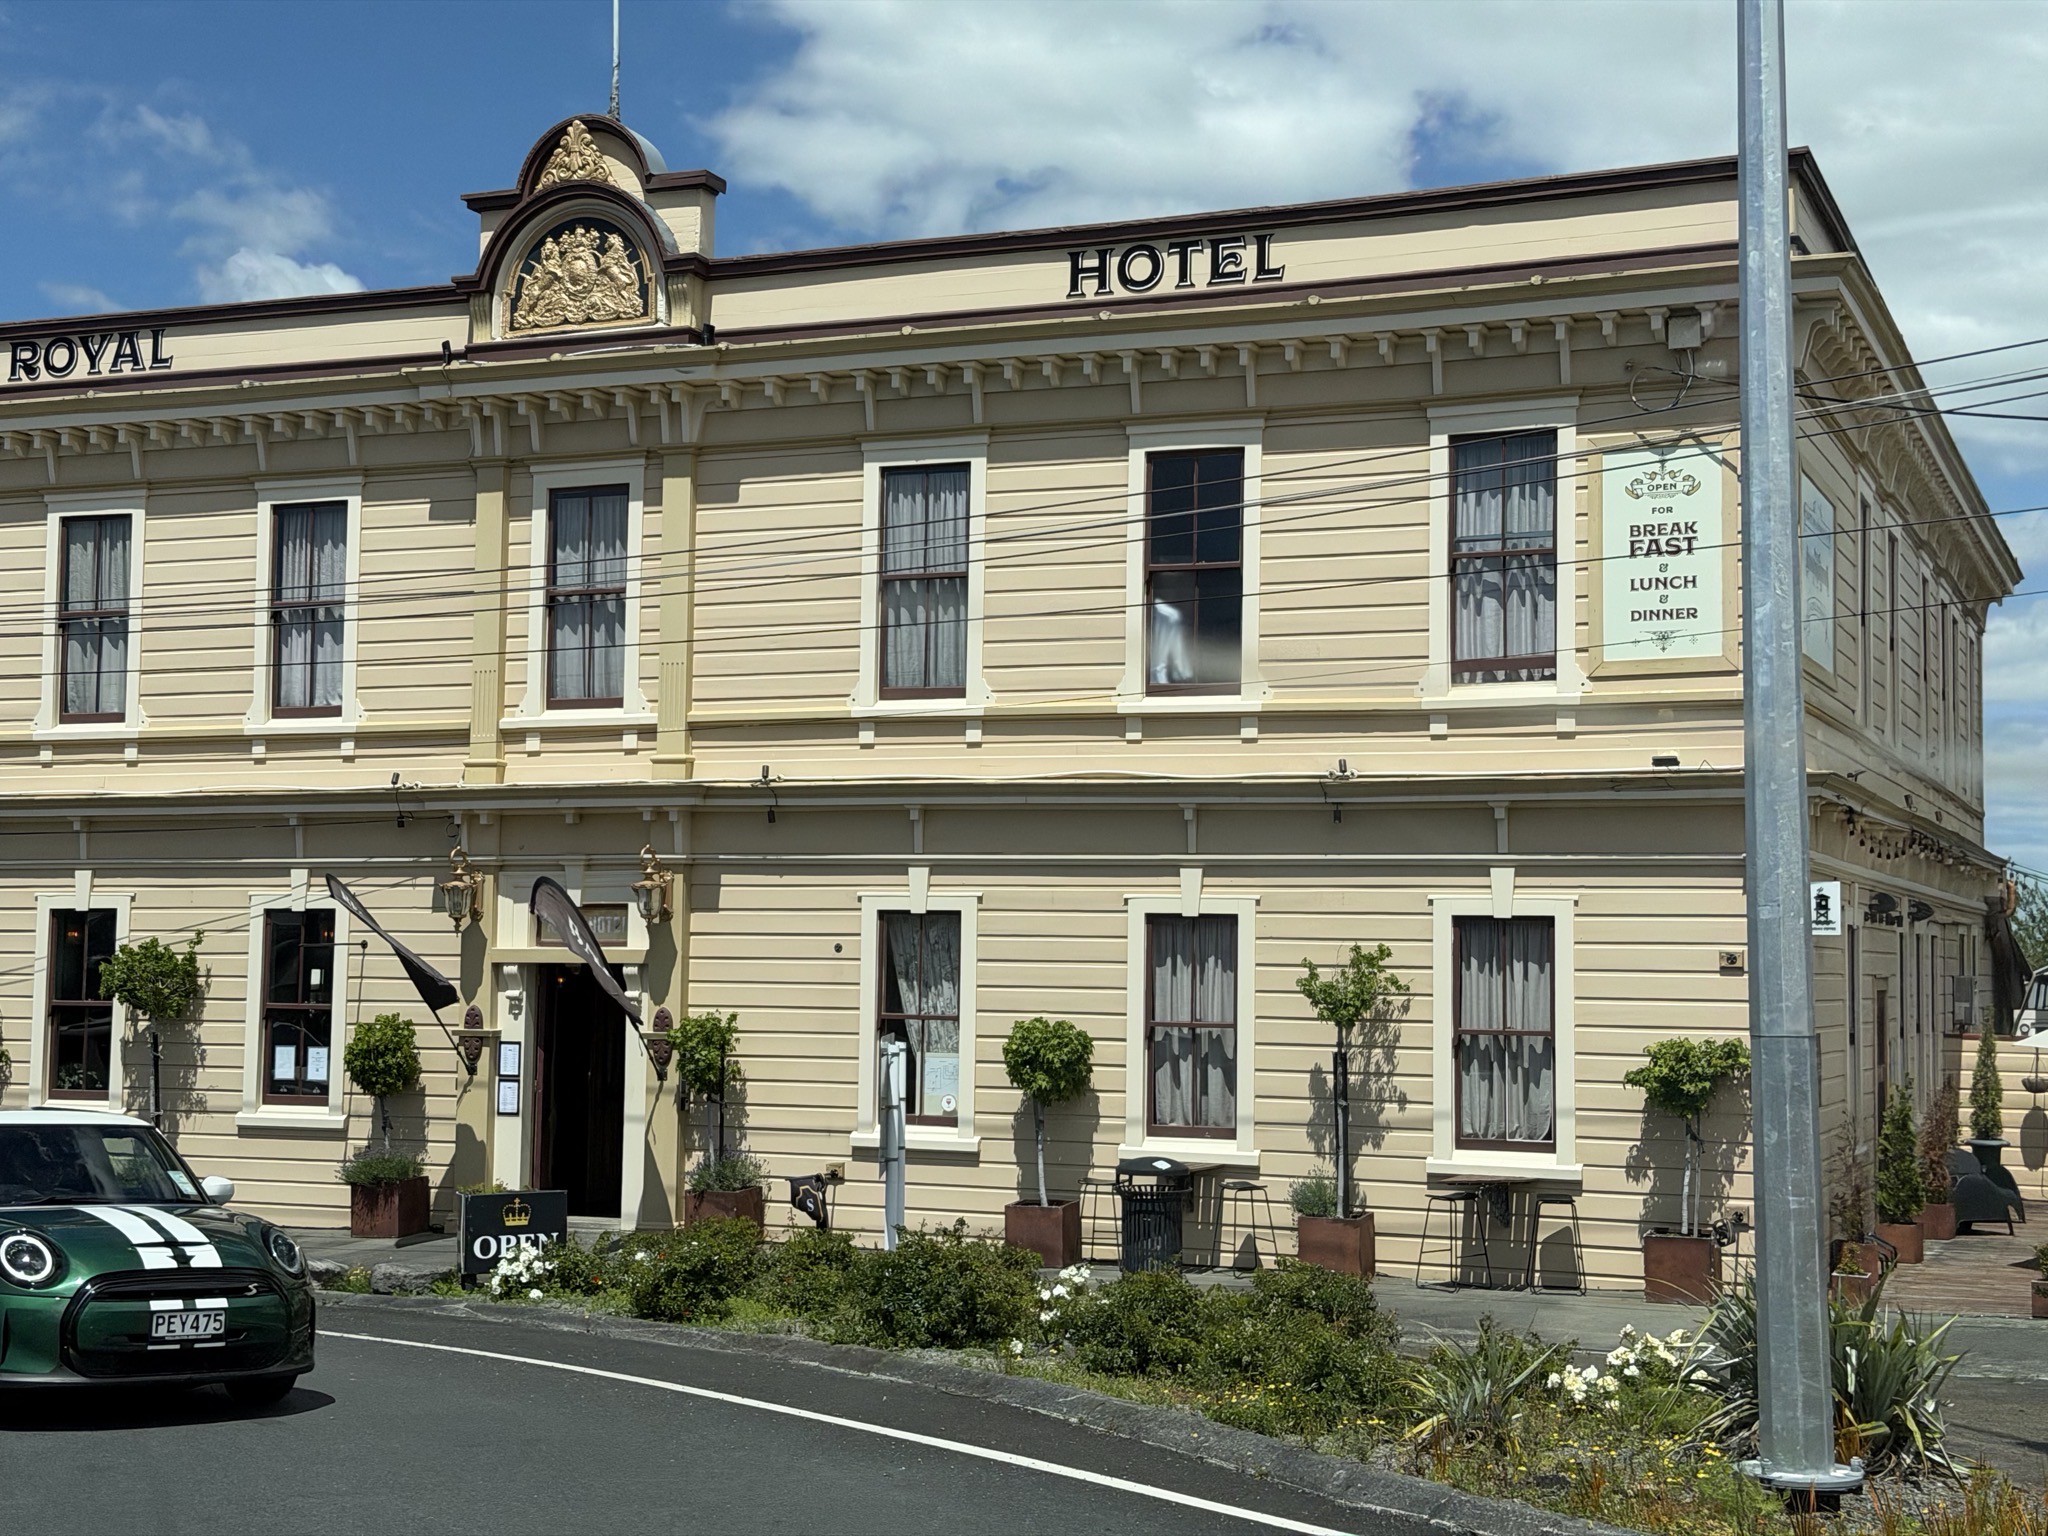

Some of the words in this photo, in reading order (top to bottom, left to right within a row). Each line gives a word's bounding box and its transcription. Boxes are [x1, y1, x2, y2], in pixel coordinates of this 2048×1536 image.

[1066, 233, 1285, 299] HOTEL
[8, 328, 174, 382] ROYAL
[1647, 482, 1677, 492] OPEN
[1651, 506, 1673, 514] FOR
[1629, 521, 1698, 538] BREAK
[1629, 536, 1698, 559] FAST
[1659, 563, 1669, 573] &
[1630, 575, 1698, 592] LUNCH
[1659, 594, 1669, 604] &
[1630, 607, 1698, 622] DINNER
[155, 1313, 224, 1334] PEY475
